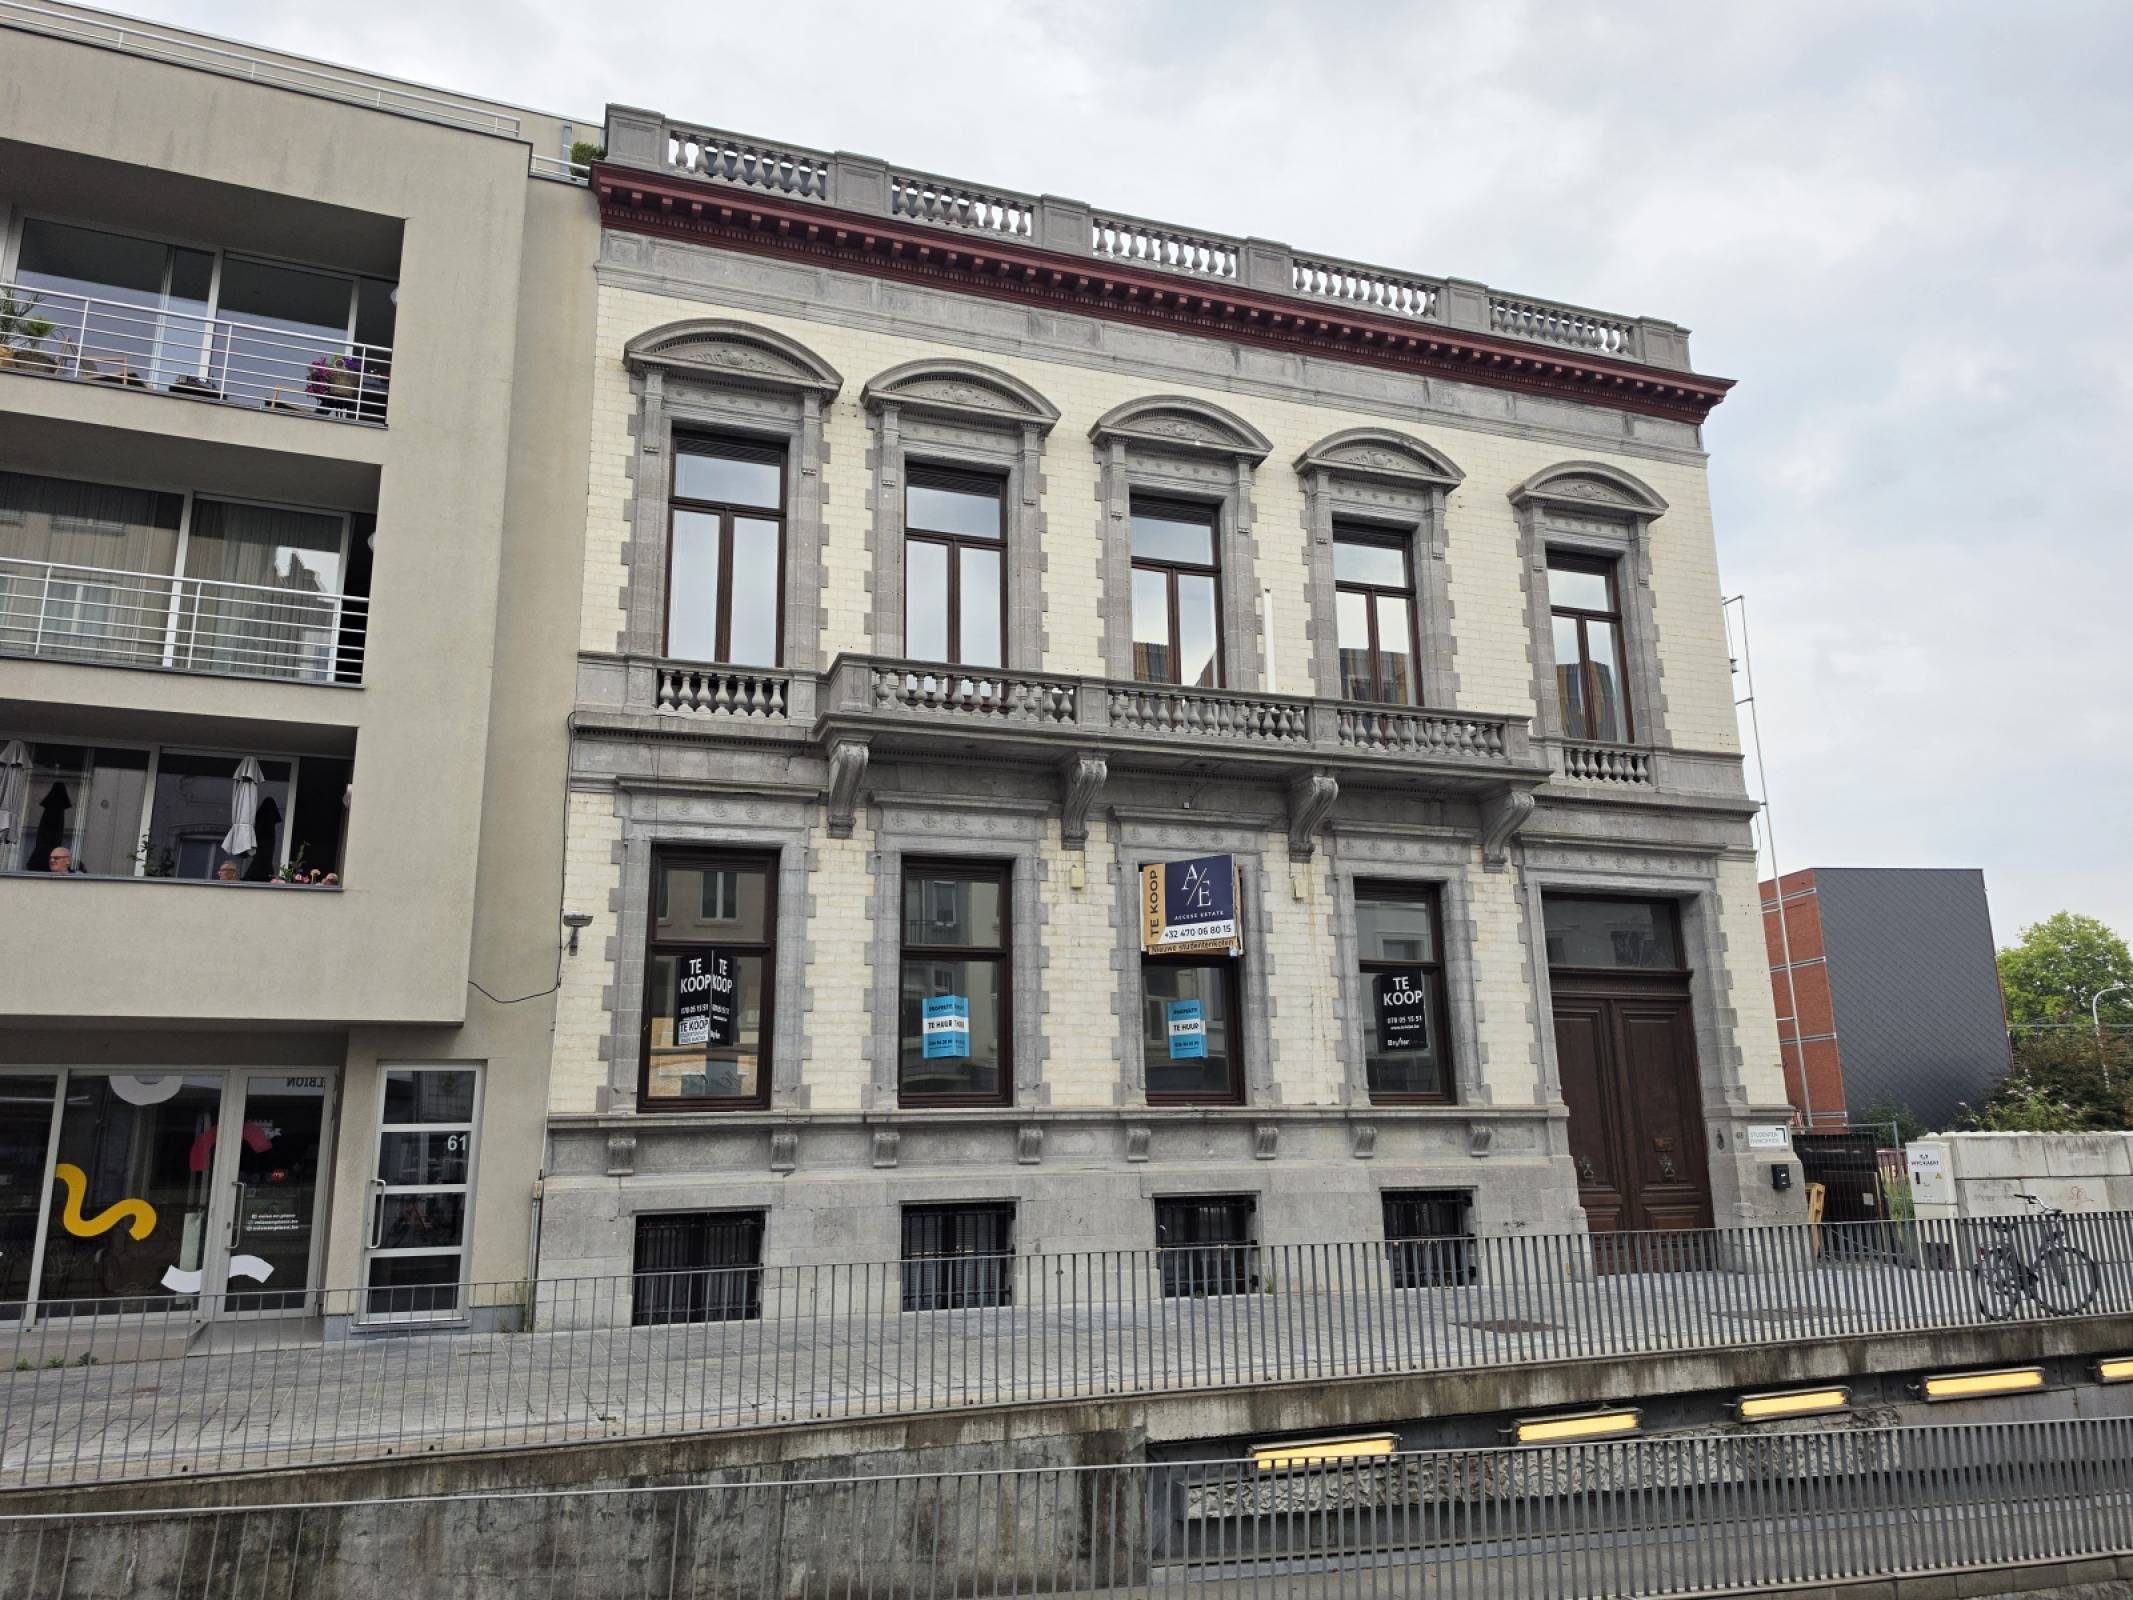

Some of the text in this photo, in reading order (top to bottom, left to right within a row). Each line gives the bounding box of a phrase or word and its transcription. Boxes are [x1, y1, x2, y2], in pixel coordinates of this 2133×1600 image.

[1149, 870, 1159, 938] TE KOOP
[1174, 910, 1224, 921] ACCESS ESTATE
[1164, 924, 1232, 939] +32 470 06 80 15
[1152, 944, 1177, 954] Nieuwe
[689, 958, 702, 975] TE
[719, 958, 728, 976] TE
[680, 974, 712, 994] KOOP
[712, 974, 733, 995] KOOP
[1392, 976, 1410, 990] TE
[1383, 990, 1423, 1006] KOOP
[680, 1021, 689, 1033] TE
[689, 1019, 709, 1031] KOOP
[928, 1021, 935, 1029] TE
[1182, 1022, 1199, 1031] HUUR
[447, 1134, 467, 1152] 61
